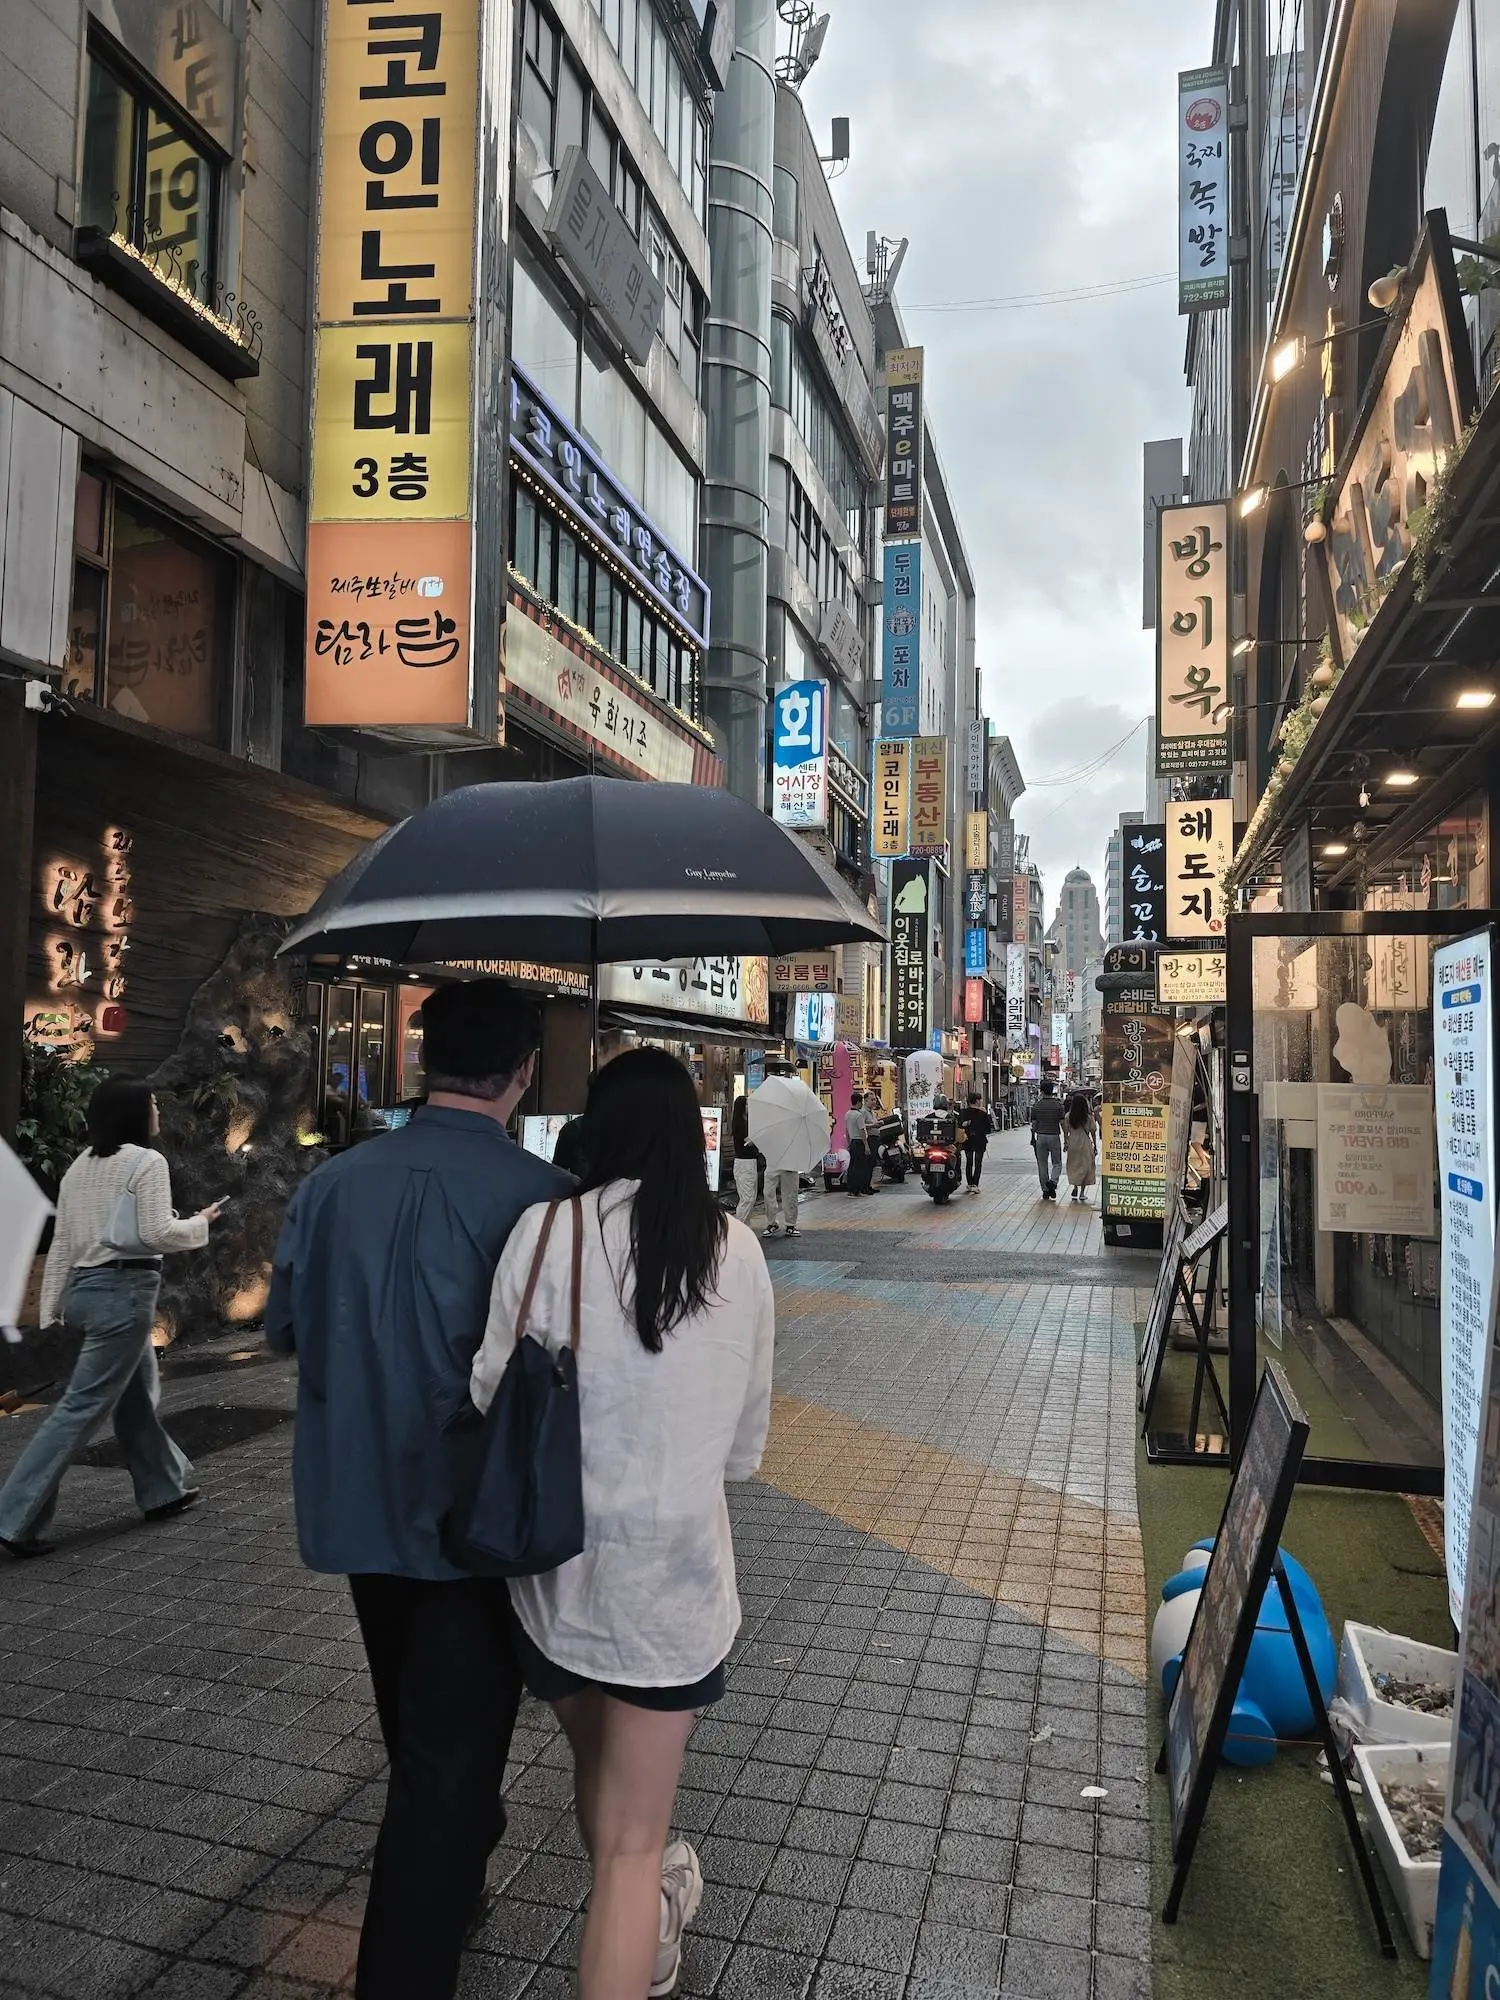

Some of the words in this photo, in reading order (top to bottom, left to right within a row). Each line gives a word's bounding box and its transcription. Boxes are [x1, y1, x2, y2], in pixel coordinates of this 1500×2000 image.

[1183, 290, 1225, 303] 722-9758
[351, 452, 429, 500] 3층
[1168, 526, 1222, 719] 방이옥
[892, 645, 911, 689] 포차
[588, 686, 648, 758] 육회지존
[778, 690, 822, 755] 회
[885, 706, 916, 727] 6F
[880, 743, 904, 756] 알파
[914, 741, 943, 755] 대신
[798, 763, 817, 774] 센터
[776, 774, 822, 791] 어시장
[883, 761, 899, 837] 코인노래
[914, 758, 941, 828] 부동산
[882, 841, 899, 850] 3층
[1178, 806, 1216, 923] 해도지
[970, 881, 983, 912] BAR
[894, 916, 909, 966] 이웃집
[1109, 949, 1156, 971] 방이
[1163, 957, 1226, 979] 방이옥
[476, 960, 518, 978] KOREAN
[520, 962, 538, 981] BBQ
[539, 967, 589, 990] RESTAURANT
[774, 964, 829, 981] 원룸텔
[908, 951, 924, 1033] 로바다야끼
[1119, 989, 1155, 1001] 수비드
[1106, 1002, 1148, 1015] 우대갈비
[1123, 1019, 1147, 1093] 방이옥
[1150, 1077, 1162, 1087] 2F
[1120, 1106, 1154, 1117] 대표메뉴
[1110, 1118, 1132, 1128] 수비드
[1134, 1119, 1166, 1129] 우대갈비
[1129, 1130, 1162, 1140] 우대갈비
[1124, 1163, 1142, 1173] 양념
[1118, 1194, 1166, 1208] 737-8255
[1123, 1207, 1153, 1217] 1시까지
